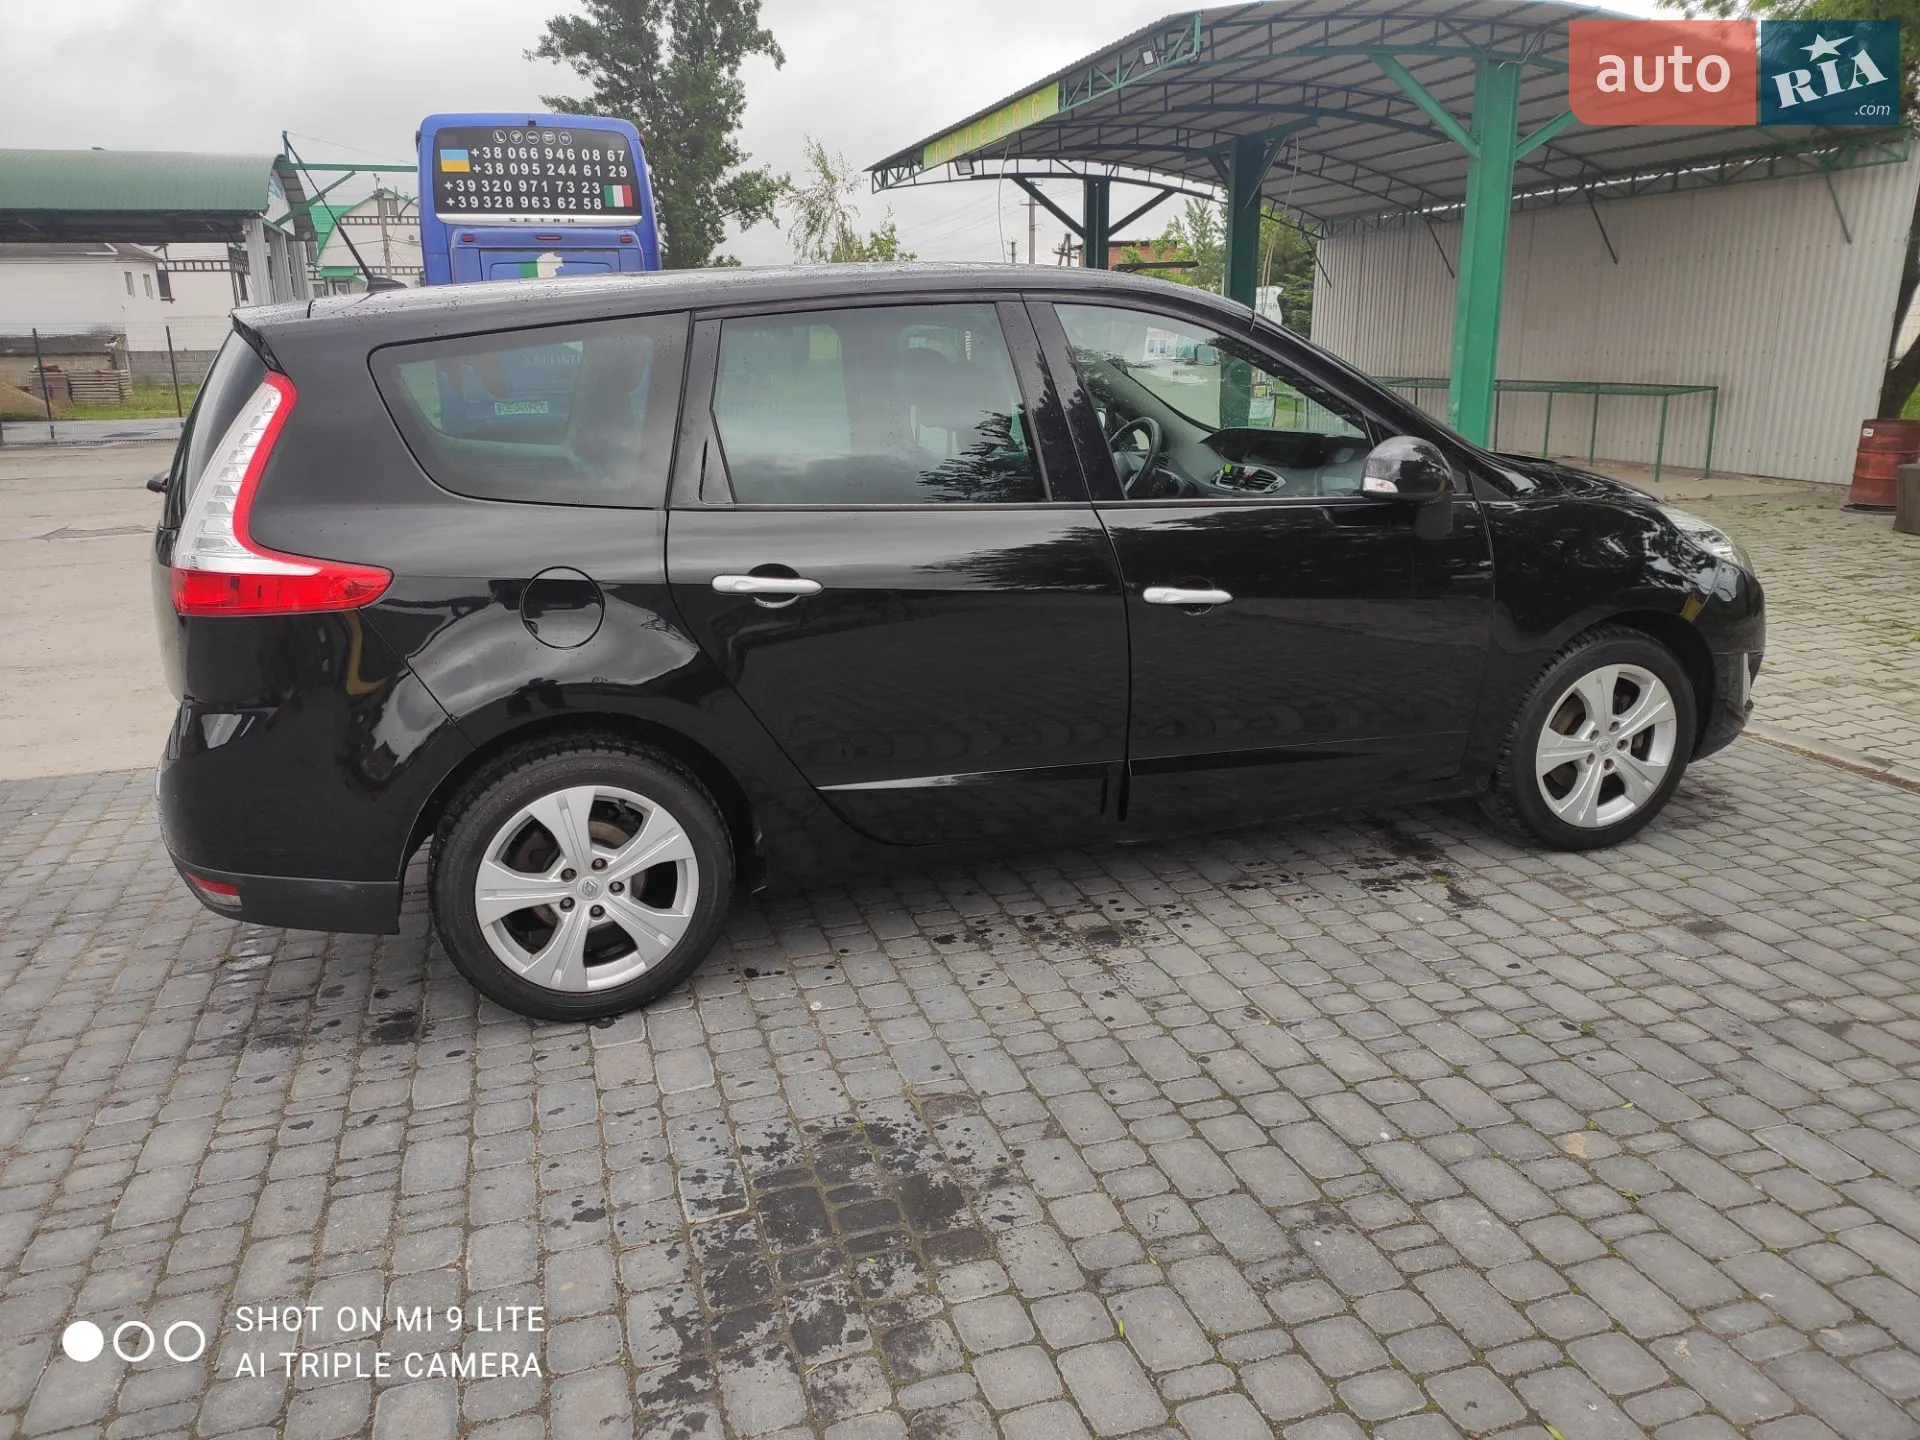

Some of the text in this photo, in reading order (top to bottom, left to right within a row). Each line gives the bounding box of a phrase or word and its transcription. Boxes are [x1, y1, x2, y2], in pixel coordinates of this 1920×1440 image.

[471, 146, 626, 162] +38 066 946 08 67
[472, 162, 628, 178] +38 095 244 61 29
[444, 179, 600, 195] +39 320 971 73 23
[446, 195, 602, 210] +39 328 963 62 58
